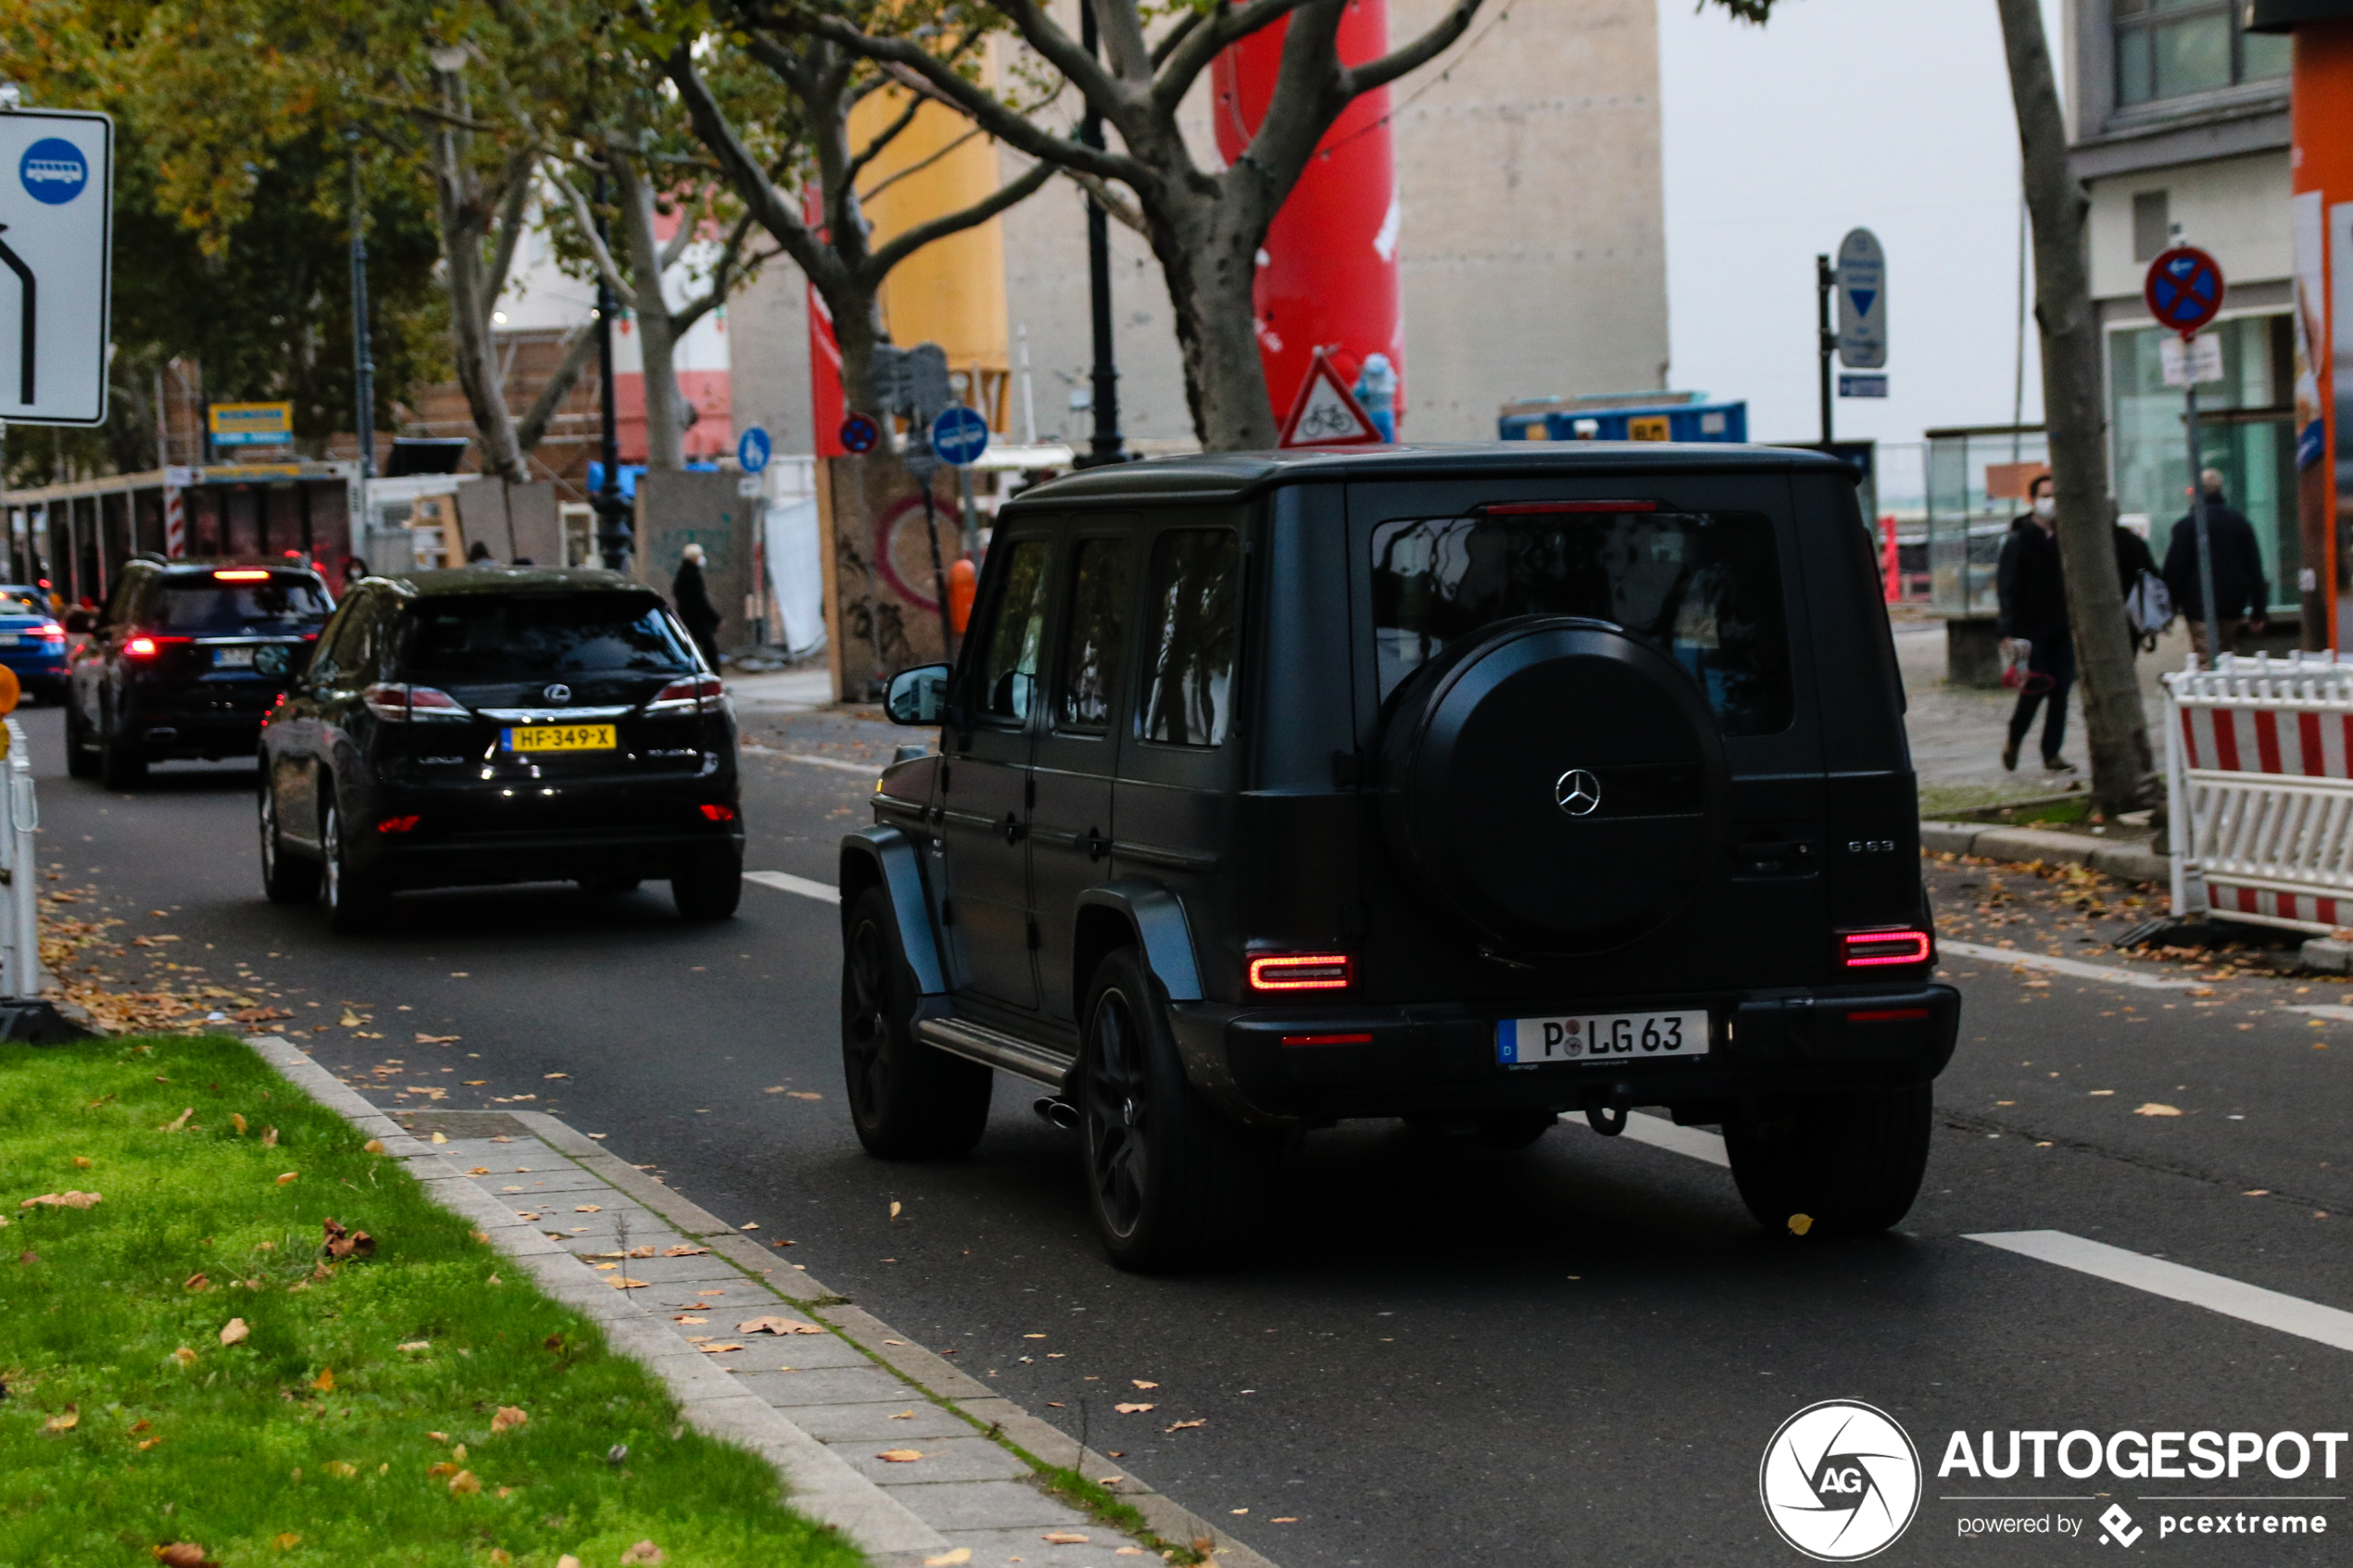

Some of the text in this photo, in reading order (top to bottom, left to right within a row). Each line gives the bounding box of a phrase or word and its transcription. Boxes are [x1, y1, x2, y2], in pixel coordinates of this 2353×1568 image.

[521, 727, 608, 746] HF-349-X
[1542, 1022, 1564, 1056] P
[1504, 1046, 1512, 1056] D
